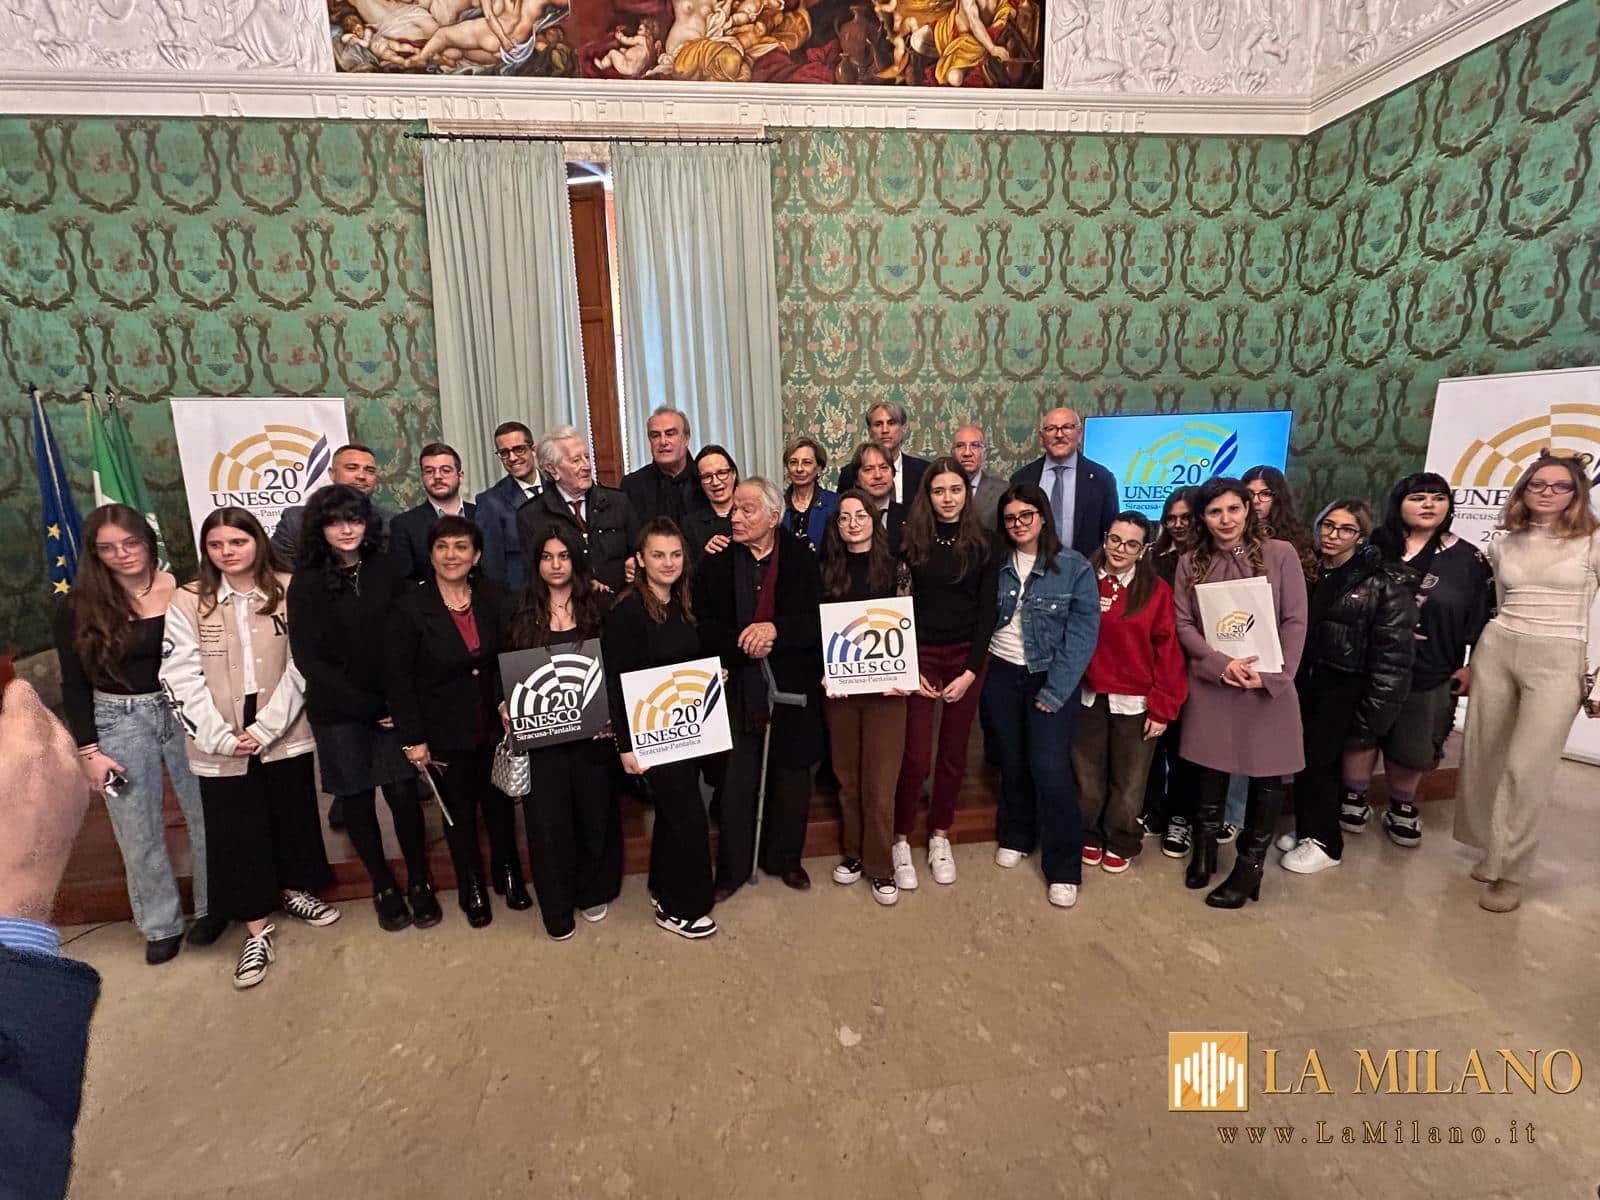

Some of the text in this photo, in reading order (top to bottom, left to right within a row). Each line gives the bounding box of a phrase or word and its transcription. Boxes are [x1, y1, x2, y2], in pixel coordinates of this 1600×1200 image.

[200, 92, 245, 117] LA
[312, 93, 506, 120] LEGGENDA
[210, 490, 302, 507] UNESCO
[1124, 485, 1173, 499] UNES
[1452, 488, 1511, 506] UNE
[828, 659, 906, 675] UNESCO
[511, 708, 581, 731] UNESCO
[635, 723, 701, 746] UNESCO
